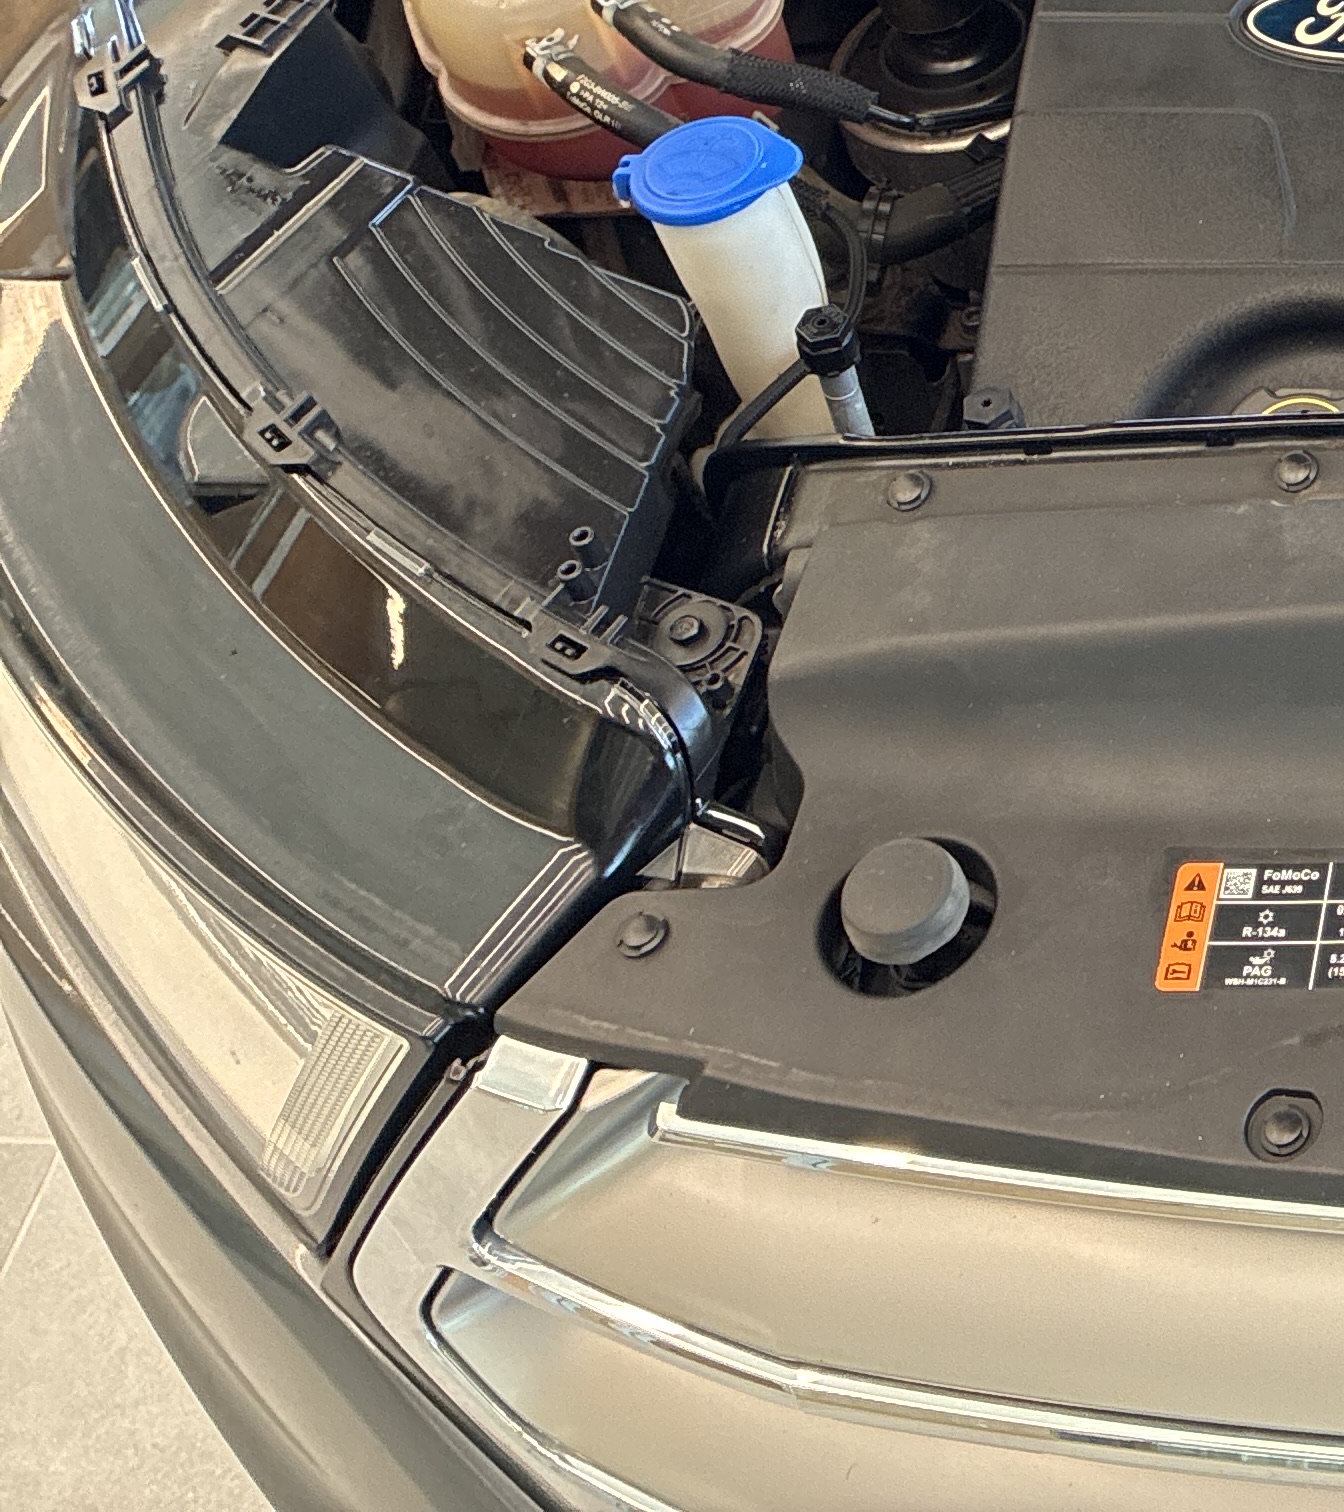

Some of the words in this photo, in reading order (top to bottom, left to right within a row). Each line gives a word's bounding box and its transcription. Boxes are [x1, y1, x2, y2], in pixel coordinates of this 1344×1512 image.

[1263, 868, 1320, 881] FoMoCo
[1261, 884, 1281, 894] SAE
[1242, 926, 1286, 937] R-134a
[1242, 965, 1272, 976] PAG
